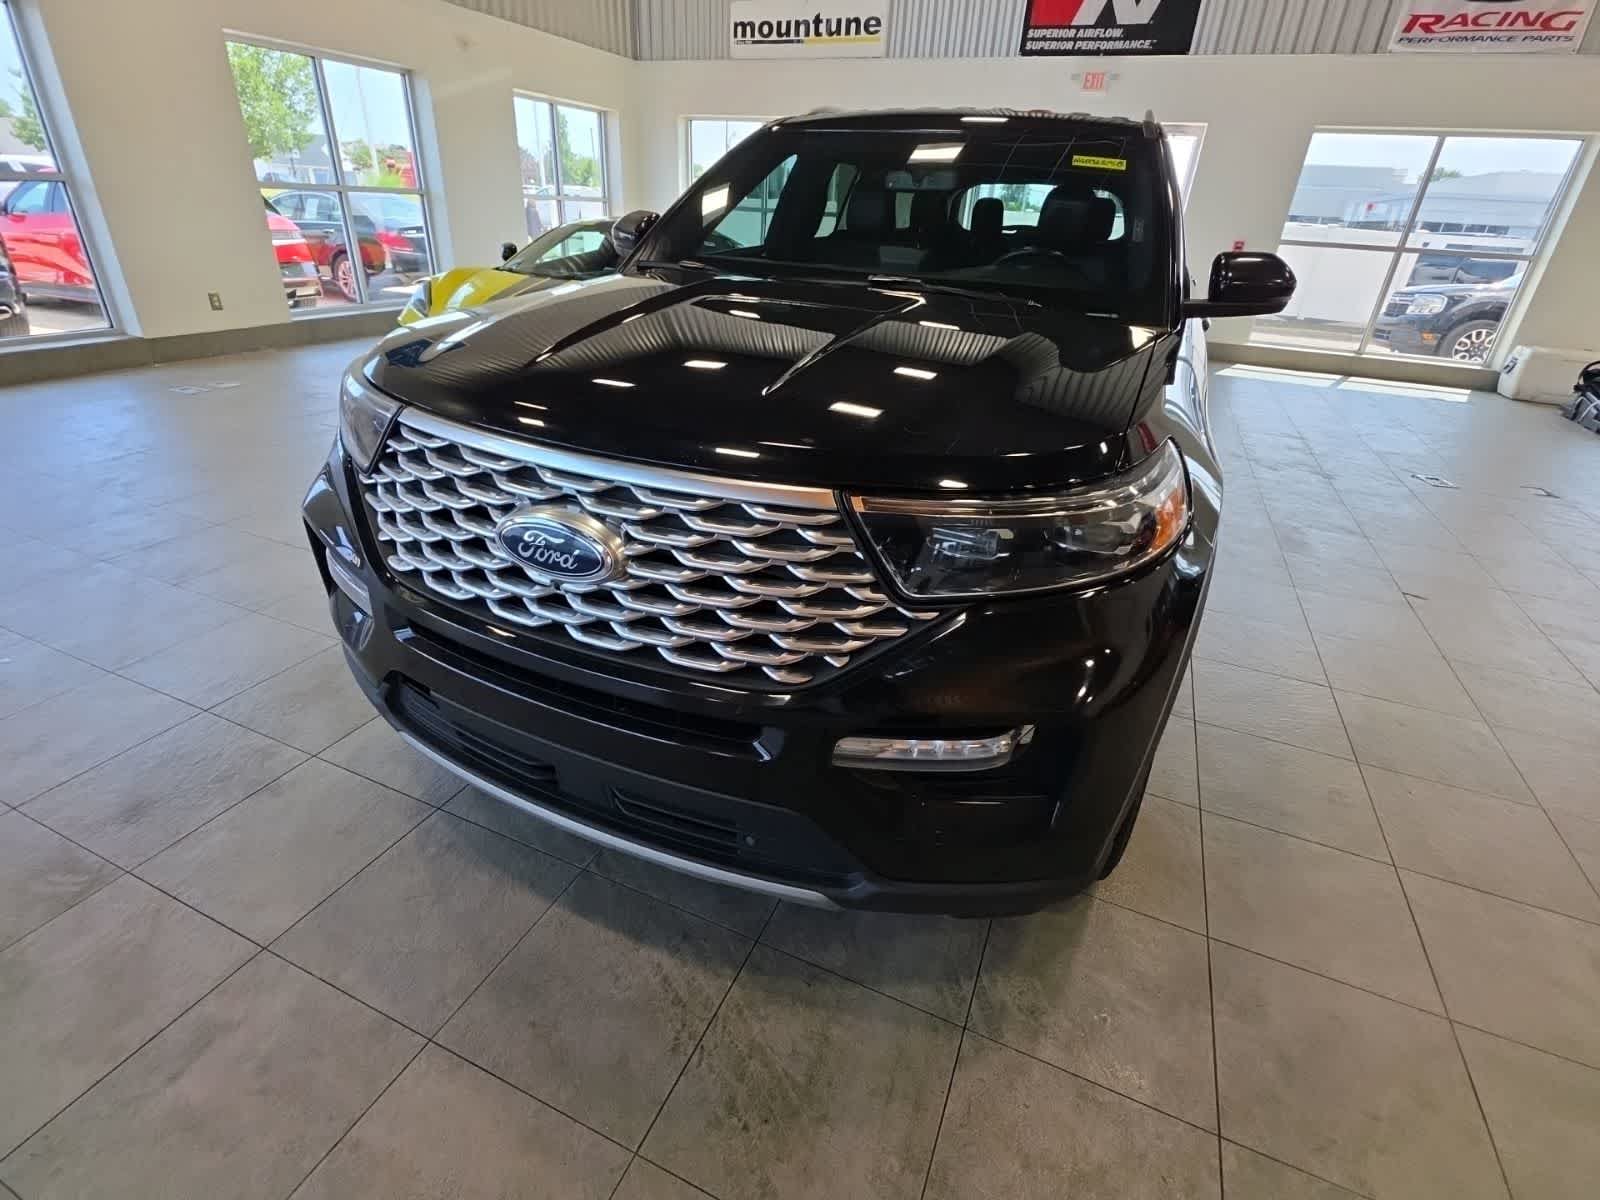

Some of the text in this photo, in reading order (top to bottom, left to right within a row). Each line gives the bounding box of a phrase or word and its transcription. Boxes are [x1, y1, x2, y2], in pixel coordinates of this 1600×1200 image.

[733, 12, 882, 39] mountune
[1402, 11, 1584, 33] RACING
[1026, 27, 1124, 39] SUPERIOR AIRFLOW.
[1398, 34, 1577, 44] PERFORMANCE PARTS
[1025, 40, 1074, 50] SUPERIOR
[1082, 71, 1105, 89] EXIT
[518, 529, 580, 569] Ford
